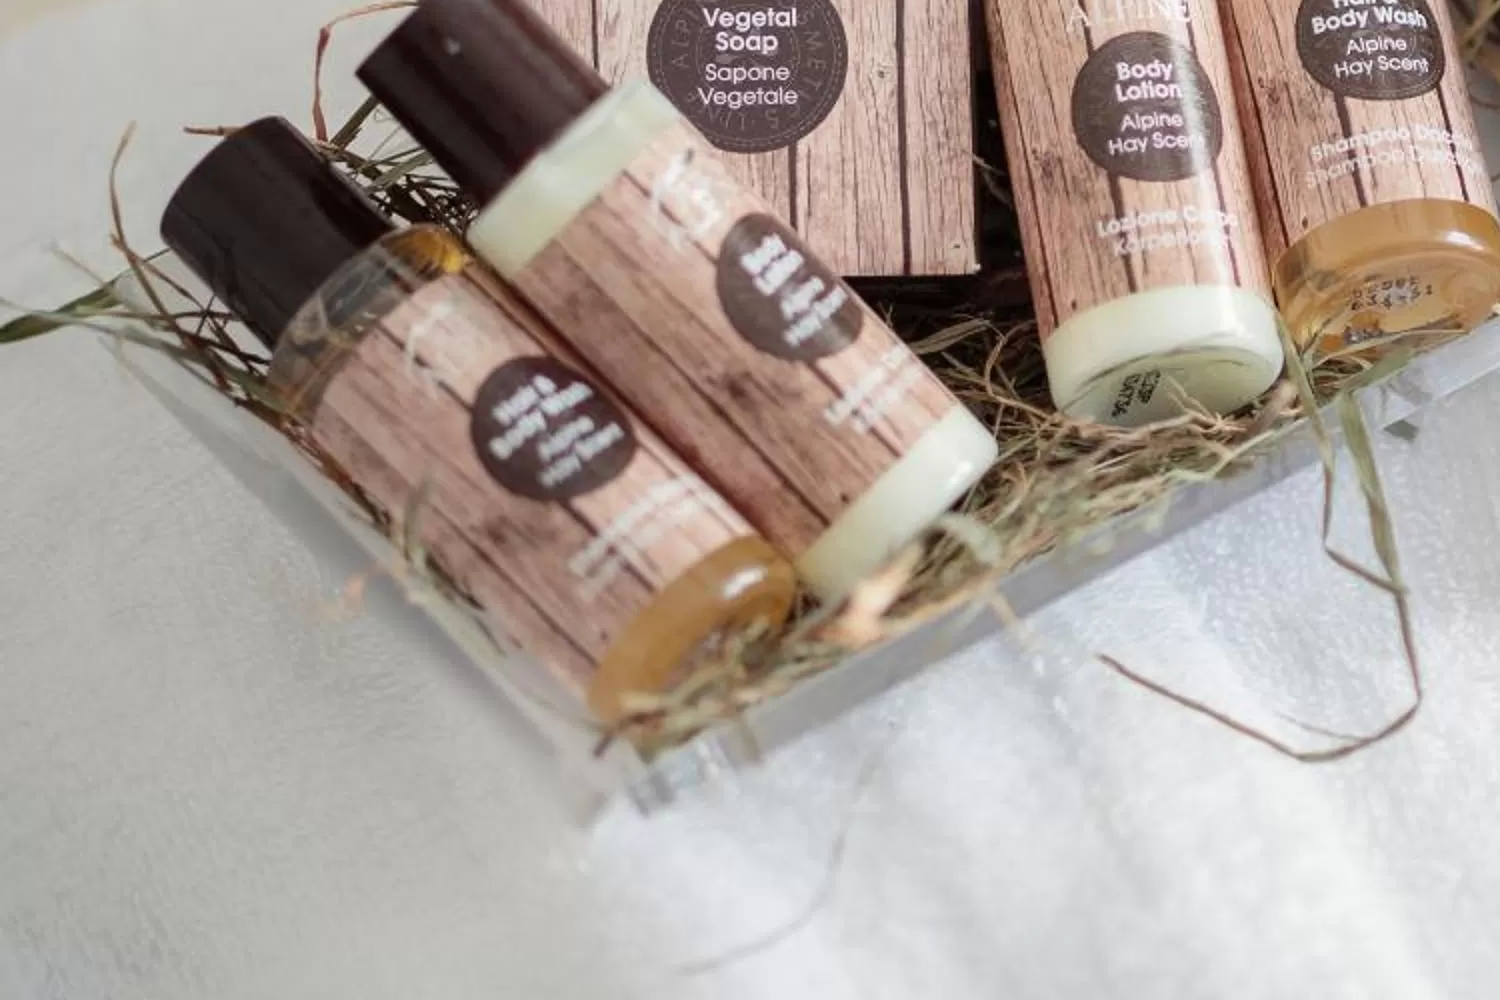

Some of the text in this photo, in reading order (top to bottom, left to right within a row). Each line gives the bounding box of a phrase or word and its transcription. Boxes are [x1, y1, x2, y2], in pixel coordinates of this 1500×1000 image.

[702, 7, 797, 31] Vegetal
[1311, 4, 1428, 35] Body Wash
[715, 31, 779, 55] Soap
[1346, 35, 1407, 56] Alpine
[705, 62, 790, 84] Sapone
[1115, 58, 1173, 82] Body
[1334, 54, 1430, 79] Hay Scent
[697, 85, 799, 110] Vegetale
[1115, 79, 1184, 103] Lotion
[1120, 110, 1184, 133] Alpine
[1108, 131, 1205, 157] Hay Scen
[1310, 128, 1411, 162] Shampoo
[1098, 204, 1239, 237] Lozione Cpo
